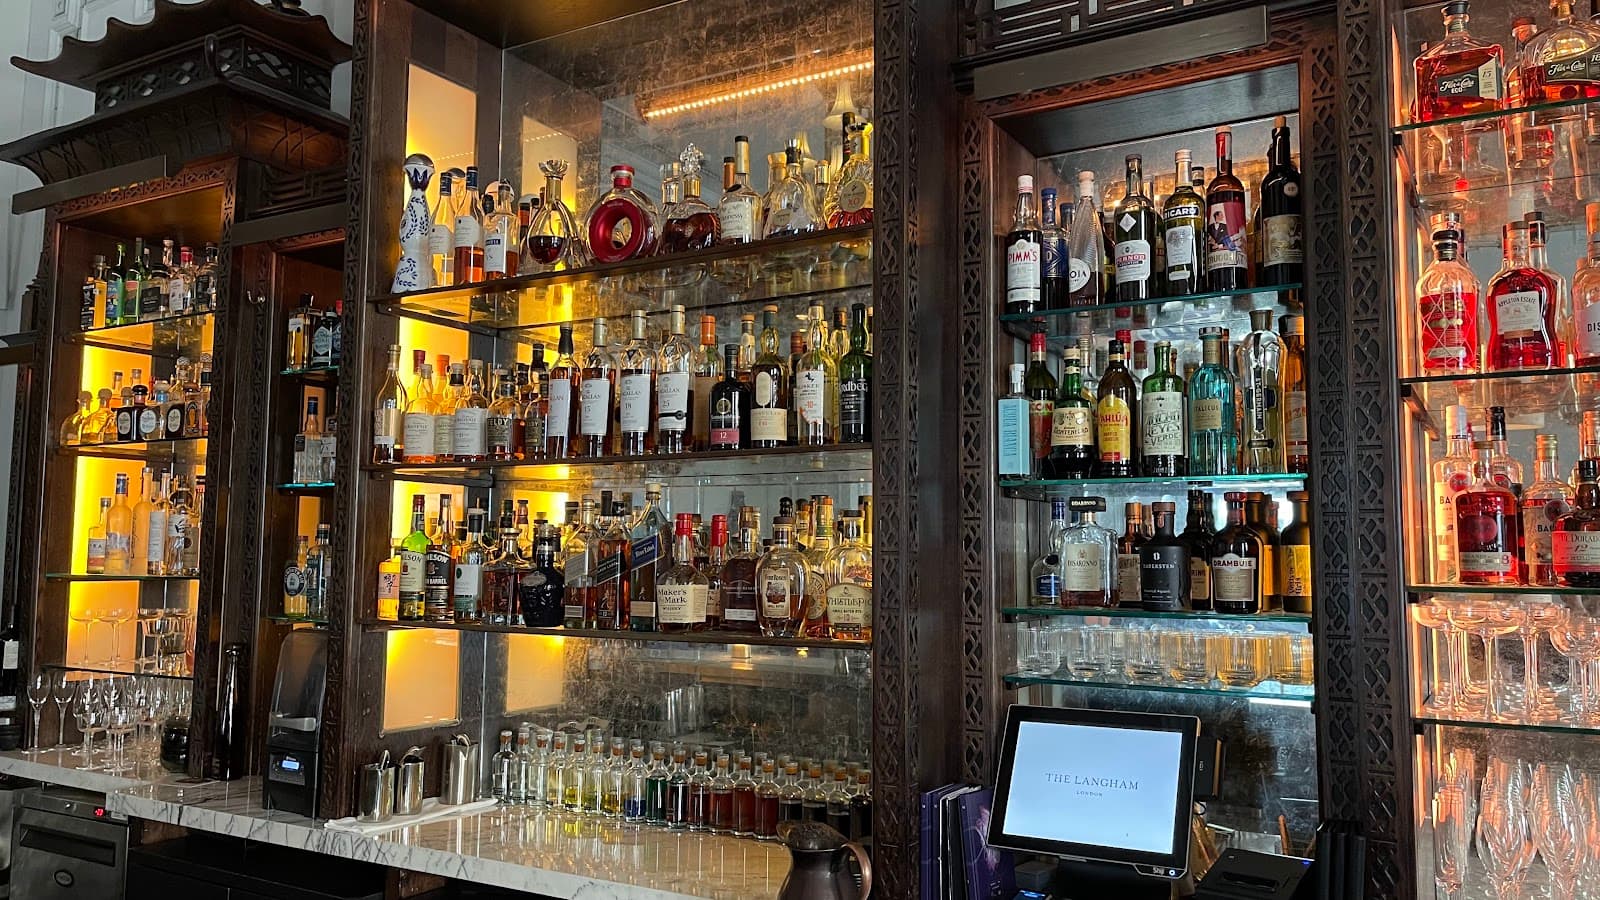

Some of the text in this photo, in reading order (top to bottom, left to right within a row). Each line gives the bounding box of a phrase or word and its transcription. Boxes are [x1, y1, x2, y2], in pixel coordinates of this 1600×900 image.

[719, 431, 727, 439] 12
[1213, 559, 1253, 568] DRAMBUIE
[658, 588, 688, 598] Maker's
[664, 597, 688, 605] Mark
[1044, 772, 1139, 791] THE LANGHAM
